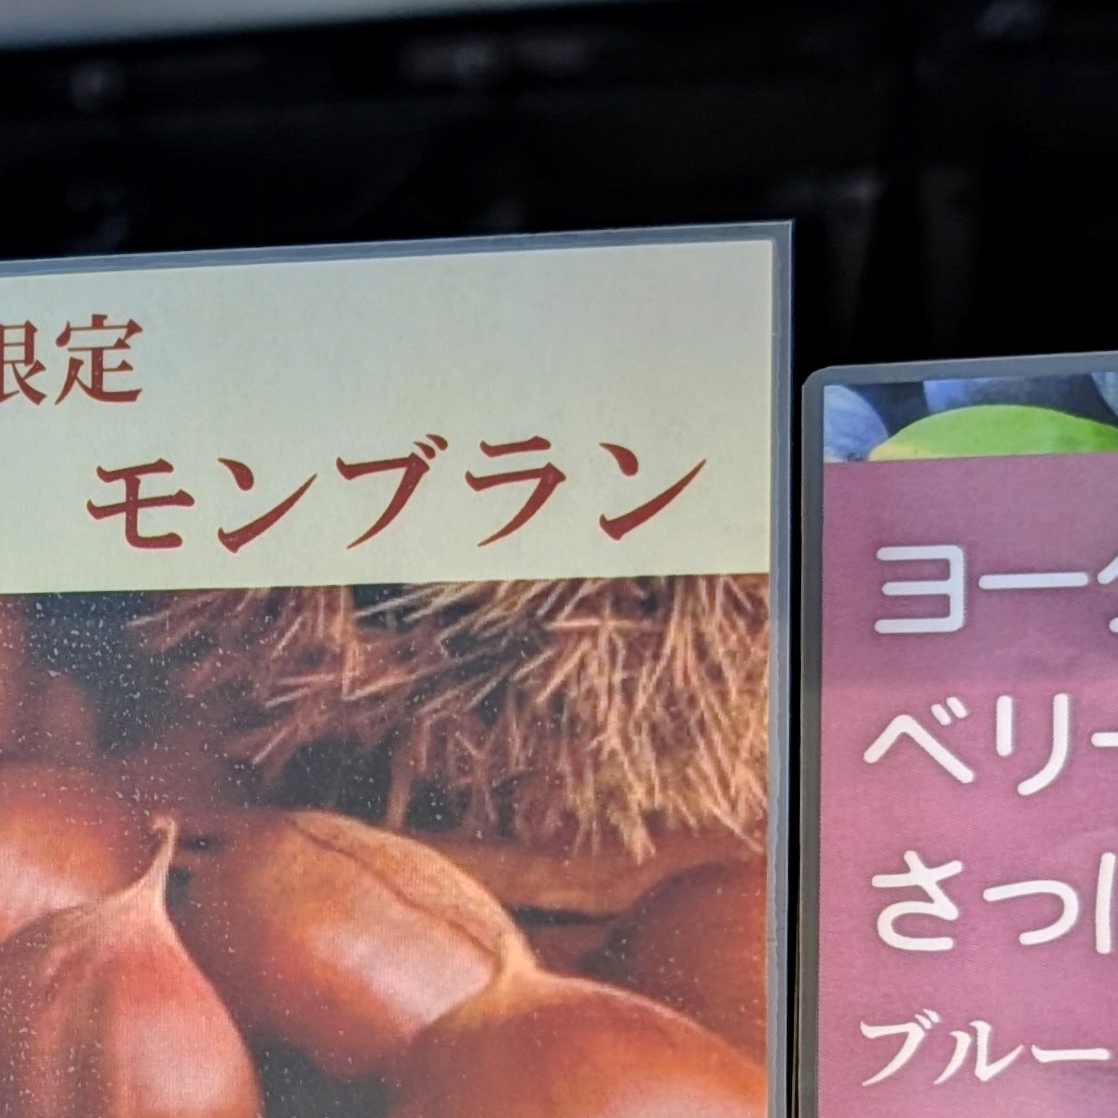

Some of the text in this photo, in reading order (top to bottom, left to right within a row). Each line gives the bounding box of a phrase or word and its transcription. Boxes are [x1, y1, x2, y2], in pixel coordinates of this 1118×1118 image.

[86, 434, 708, 554] モンブラン
[874, 545, 1118, 634] ヨー
[863, 693, 1118, 796] ベリ
[860, 1008, 1110, 1087] ブルー
